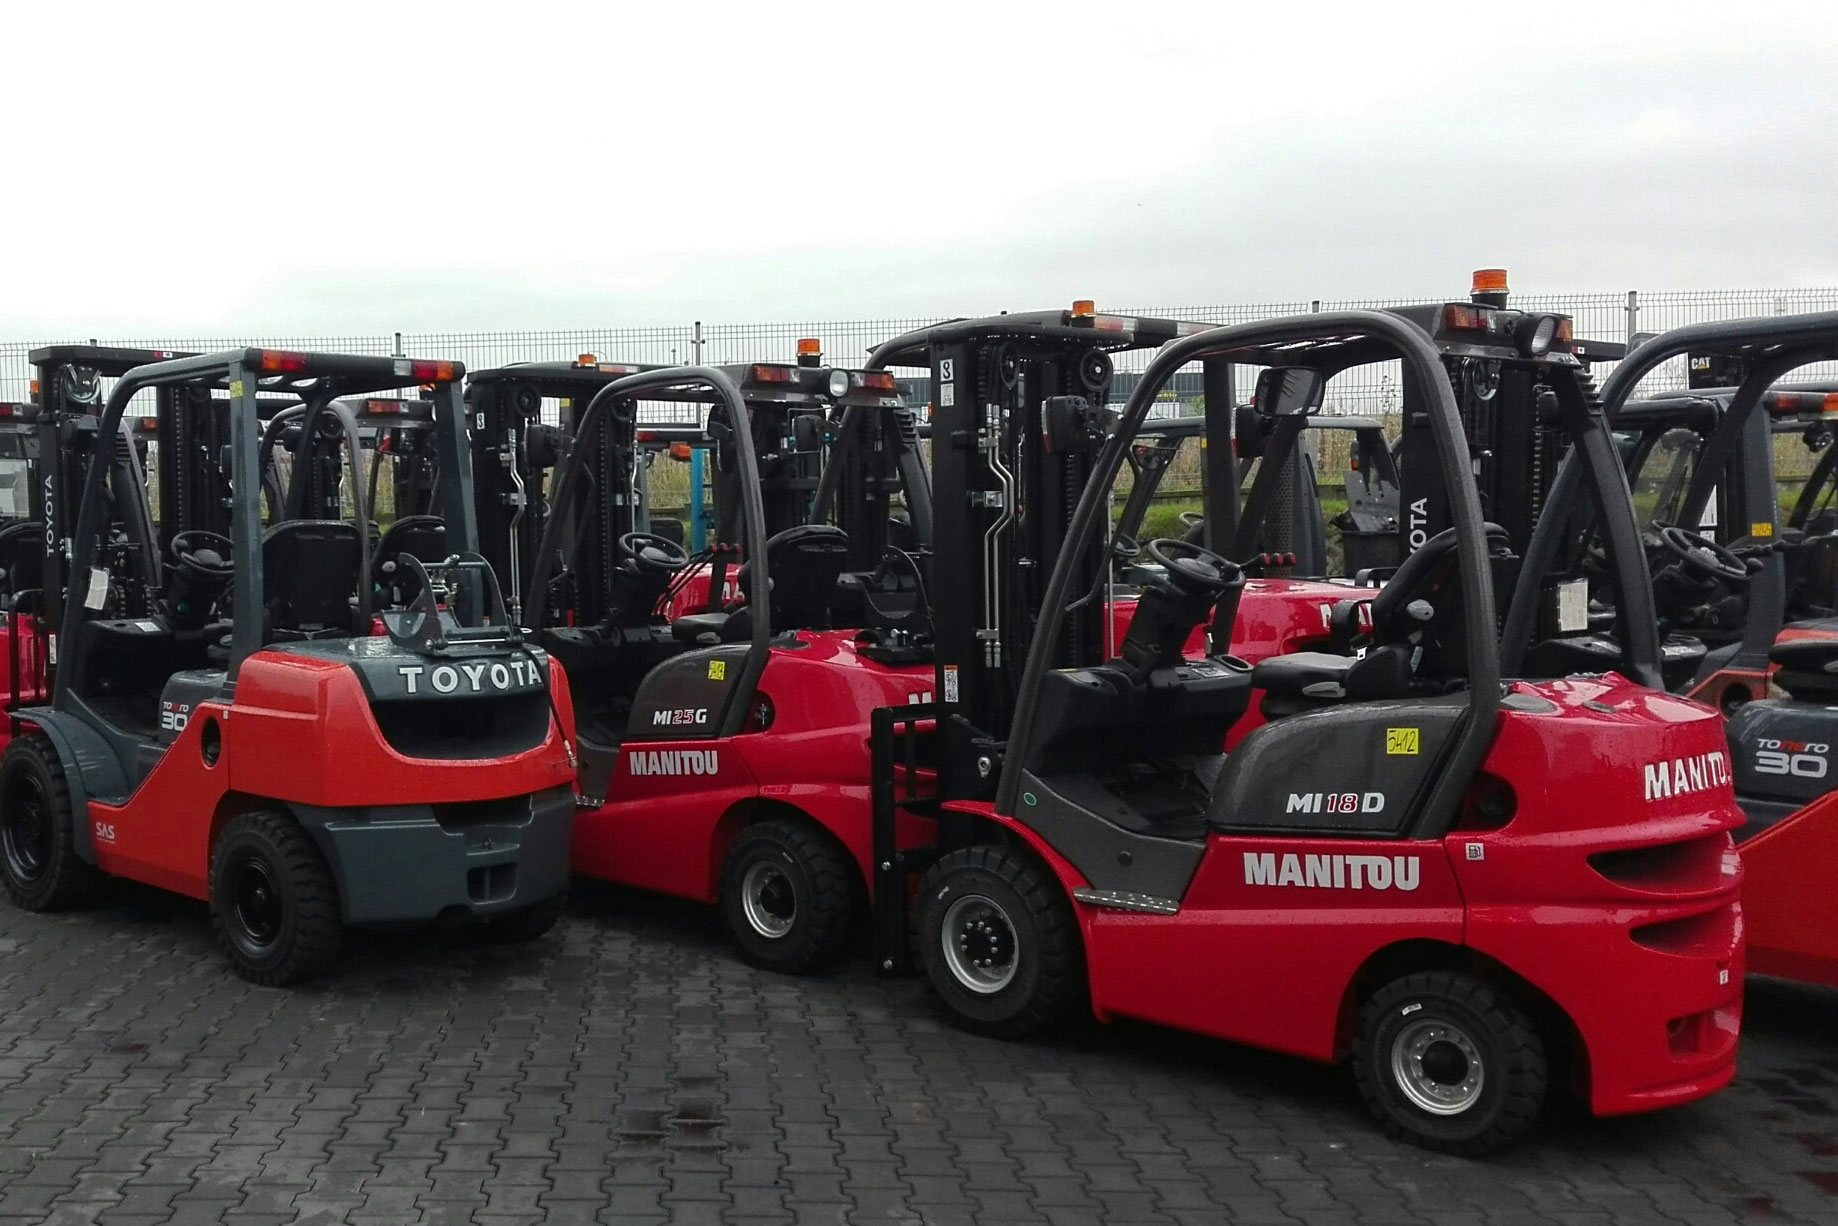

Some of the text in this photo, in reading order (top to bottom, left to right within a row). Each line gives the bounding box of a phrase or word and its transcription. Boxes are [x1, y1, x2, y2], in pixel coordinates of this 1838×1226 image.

[1691, 356, 1711, 370] CAT
[44, 474, 55, 558] TOYOTA
[399, 659, 543, 694] TOYOTA
[161, 711, 188, 732] 30
[1387, 729, 1417, 754] 5412
[629, 749, 719, 776] MANITOU
[1754, 750, 1828, 778] 30
[96, 821, 116, 840] SAS
[1243, 852, 1420, 891] MANITOU
